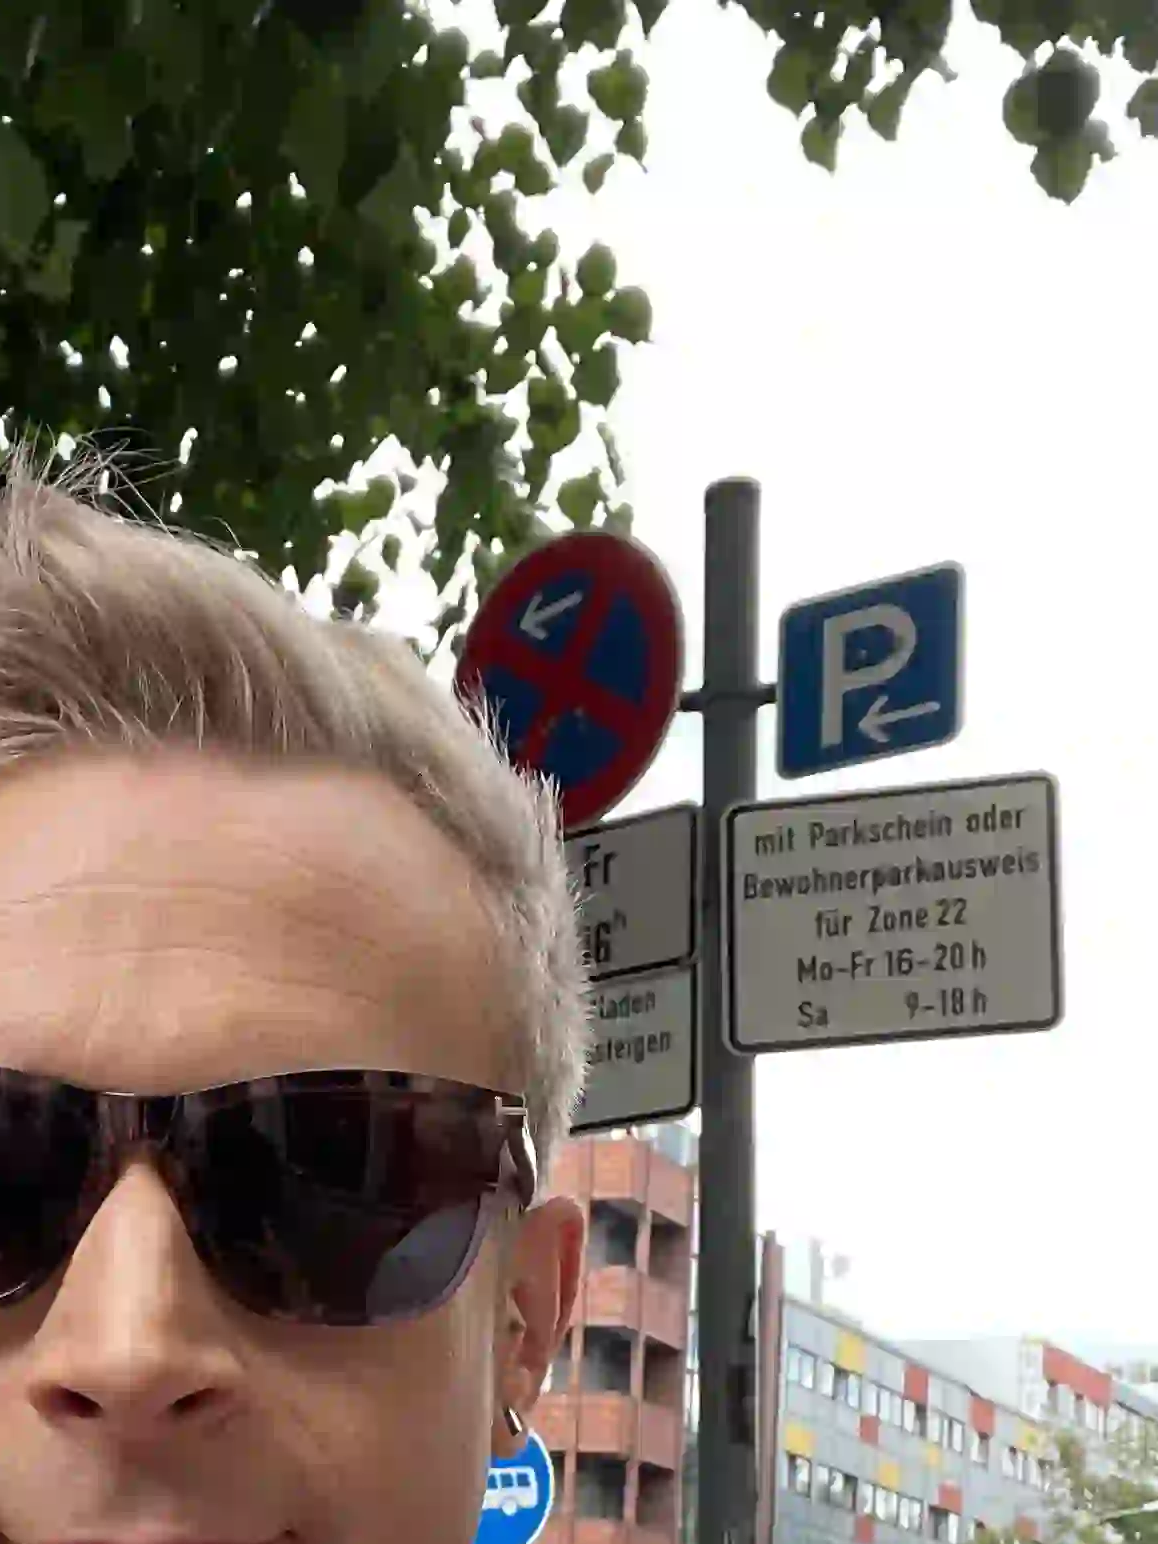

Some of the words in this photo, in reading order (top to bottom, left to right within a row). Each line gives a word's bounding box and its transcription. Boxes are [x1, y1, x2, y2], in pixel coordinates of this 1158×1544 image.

[820, 603, 916, 748] P
[754, 825, 795, 855] mit
[809, 810, 952, 849] Parkschein
[966, 803, 1026, 832] oder
[743, 846, 1041, 900] Bewohnerparkausweis
[816, 908, 852, 939] für
[868, 905, 928, 933] Zone
[935, 898, 967, 926] 22
[797, 951, 874, 983] Mo-Fr
[885, 942, 964, 977] 16-20
[971, 939, 987, 971] h
[588, 990, 656, 1019] laden
[797, 1001, 829, 1028] Sa
[904, 988, 964, 1019] 9-18
[972, 987, 988, 1015] h
[587, 1031, 671, 1064] steigen
